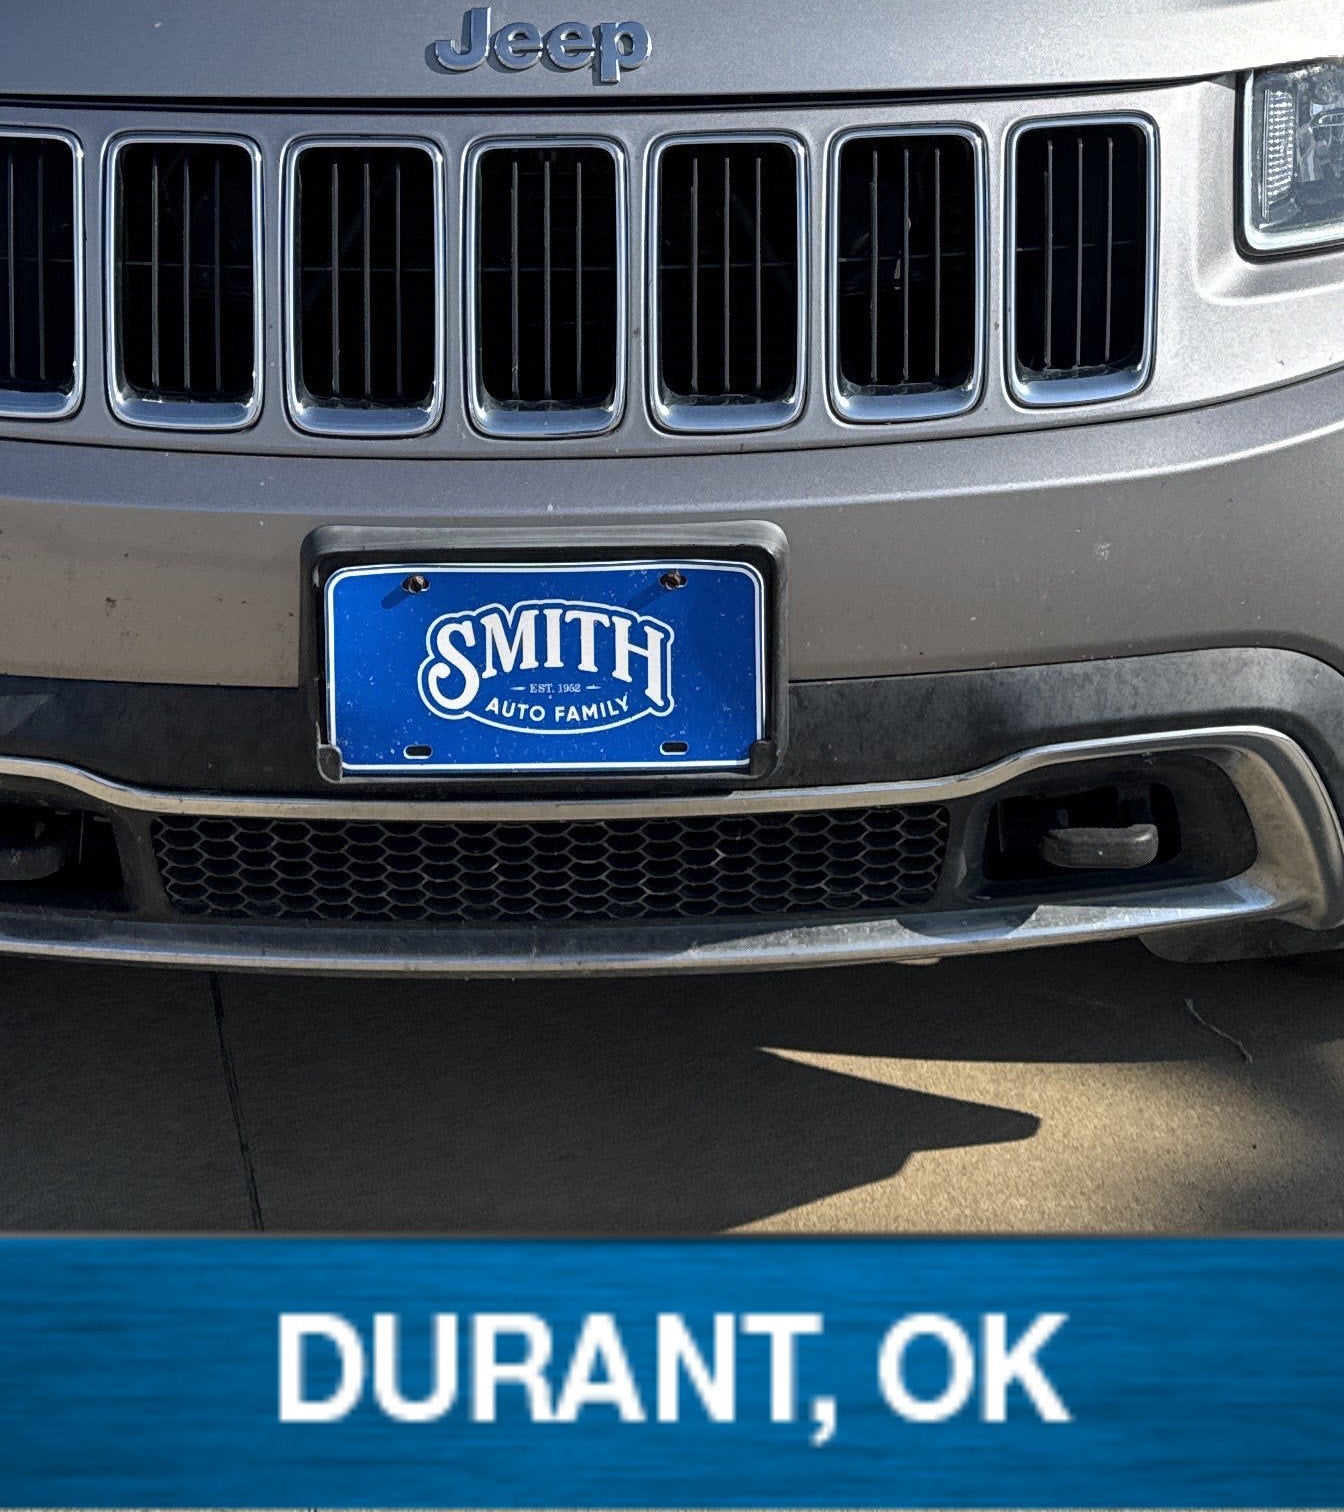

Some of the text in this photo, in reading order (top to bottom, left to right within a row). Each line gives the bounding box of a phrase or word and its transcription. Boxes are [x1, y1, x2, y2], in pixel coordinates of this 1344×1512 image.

[431, 6, 653, 85] Jeep
[427, 607, 666, 711] SMITH
[484, 694, 630, 723] AUTO FAMILY
[529, 682, 556, 694] EST.
